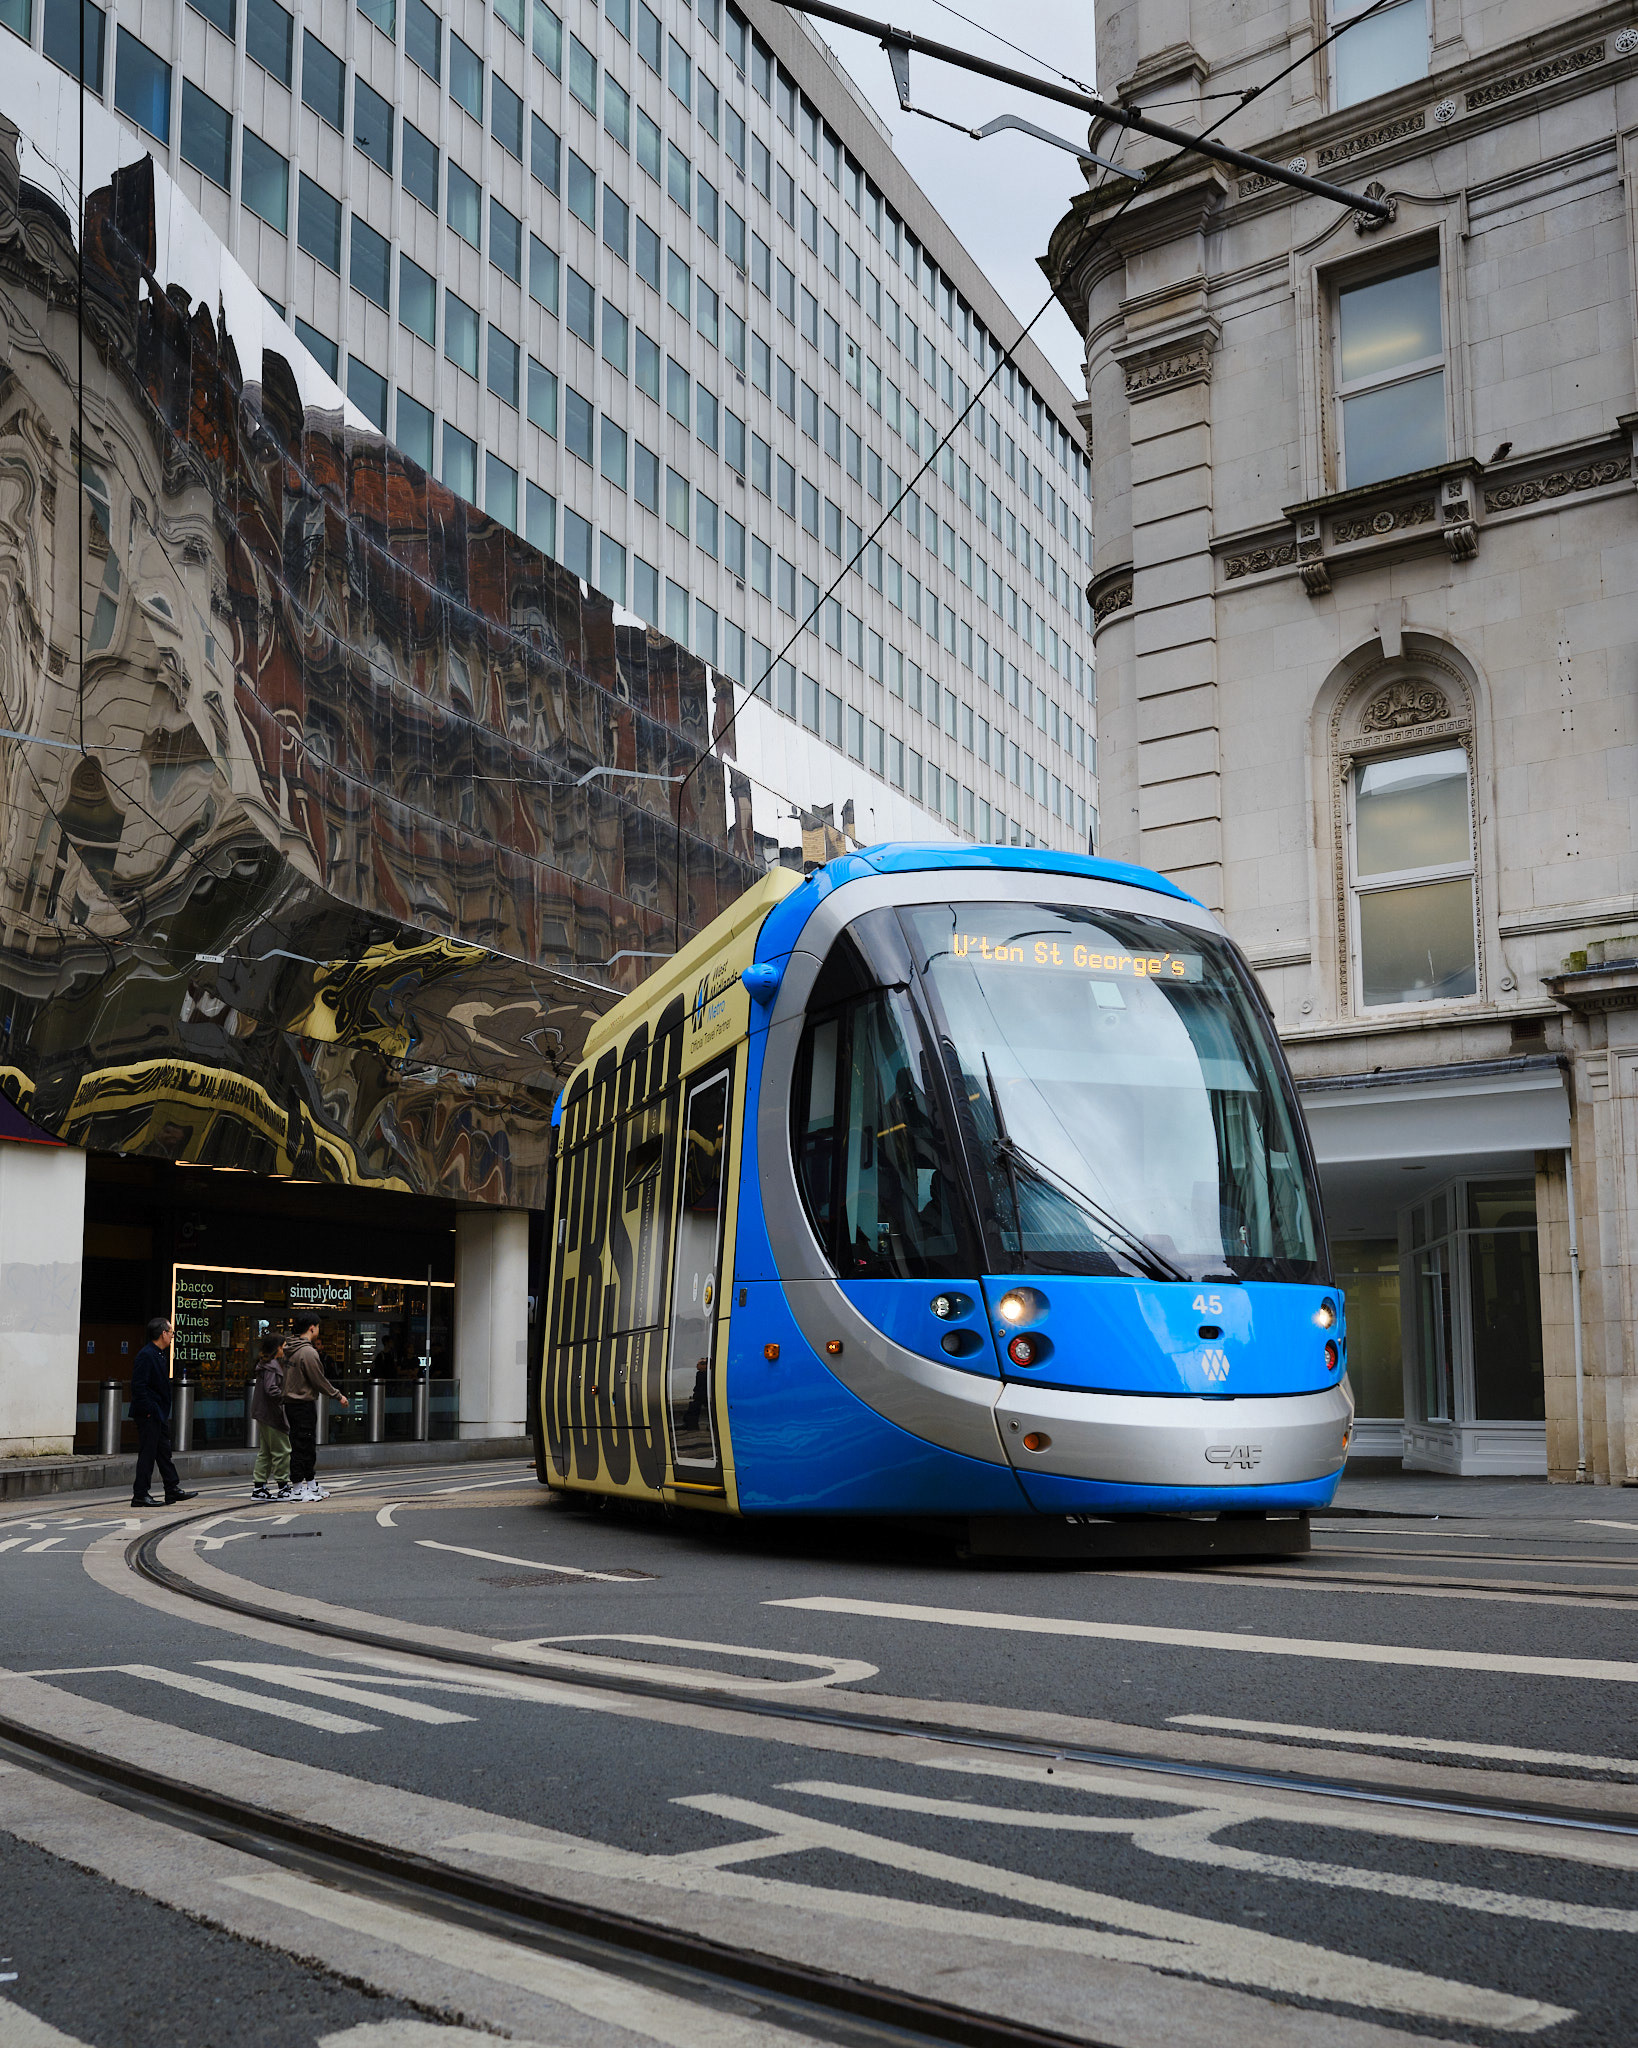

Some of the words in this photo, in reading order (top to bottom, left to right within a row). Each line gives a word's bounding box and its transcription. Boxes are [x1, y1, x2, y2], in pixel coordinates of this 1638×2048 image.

[1034, 941, 1063, 966] St
[1073, 944, 1185, 977] George's
[707, 1000, 726, 1023] Metro
[175, 1280, 214, 1292] obacco
[177, 1296, 208, 1309] Beers
[1192, 1294, 1223, 1315] 45
[175, 1313, 209, 1327] Wines
[176, 1330, 211, 1346] Spirits
[190, 1348, 216, 1361] Here
[1204, 1445, 1262, 1469] CAF
